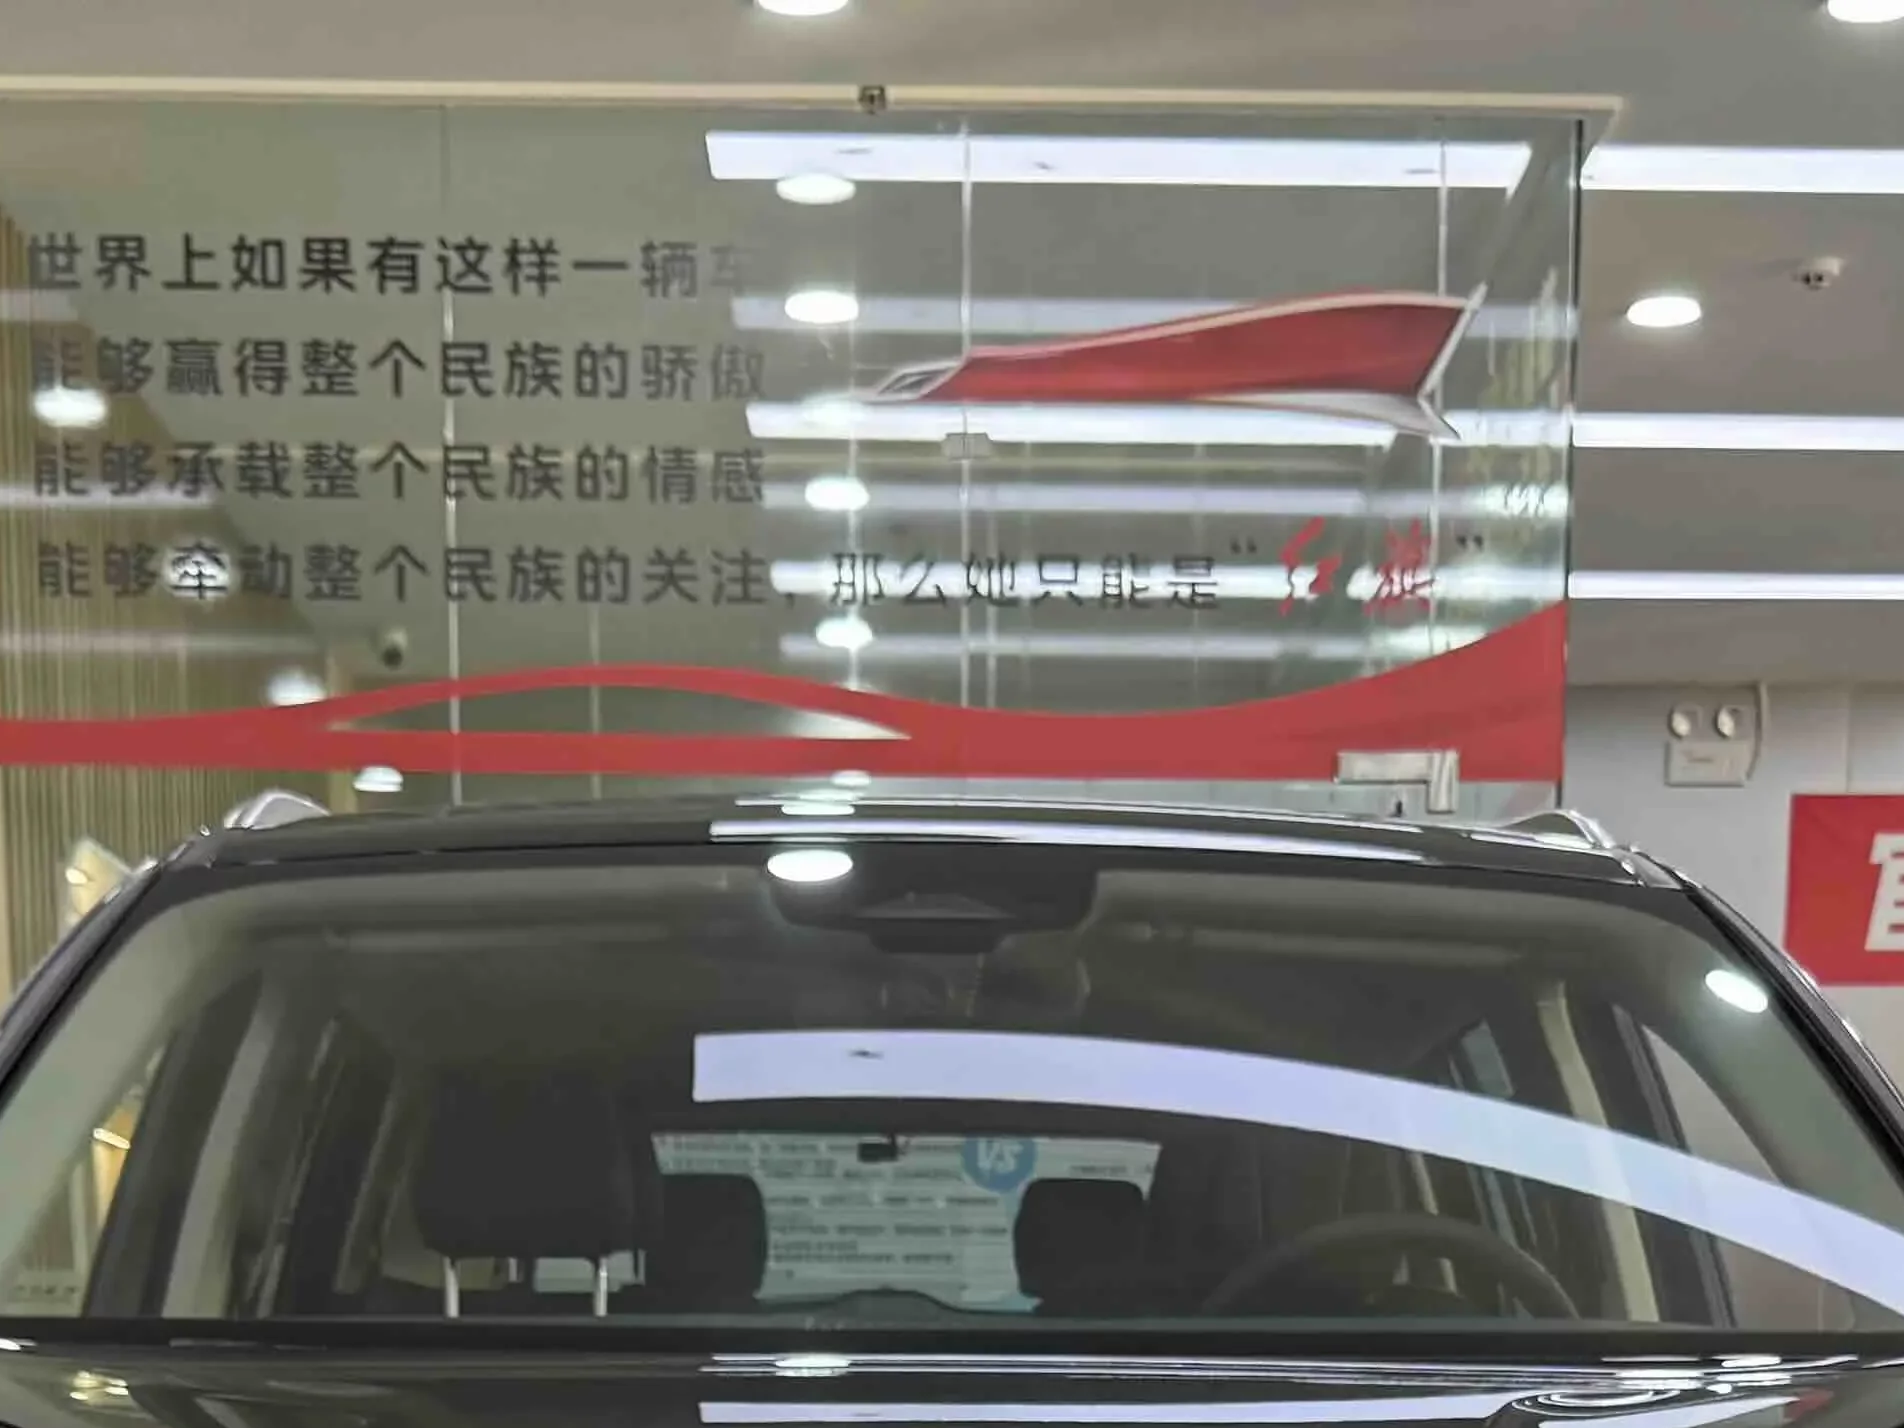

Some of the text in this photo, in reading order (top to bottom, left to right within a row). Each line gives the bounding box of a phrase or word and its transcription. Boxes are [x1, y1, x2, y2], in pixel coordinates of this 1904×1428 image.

[30, 337, 767, 400] 能够赢得整个民族的骄傲
[33, 442, 767, 503] 能够承载整个民族的情感
